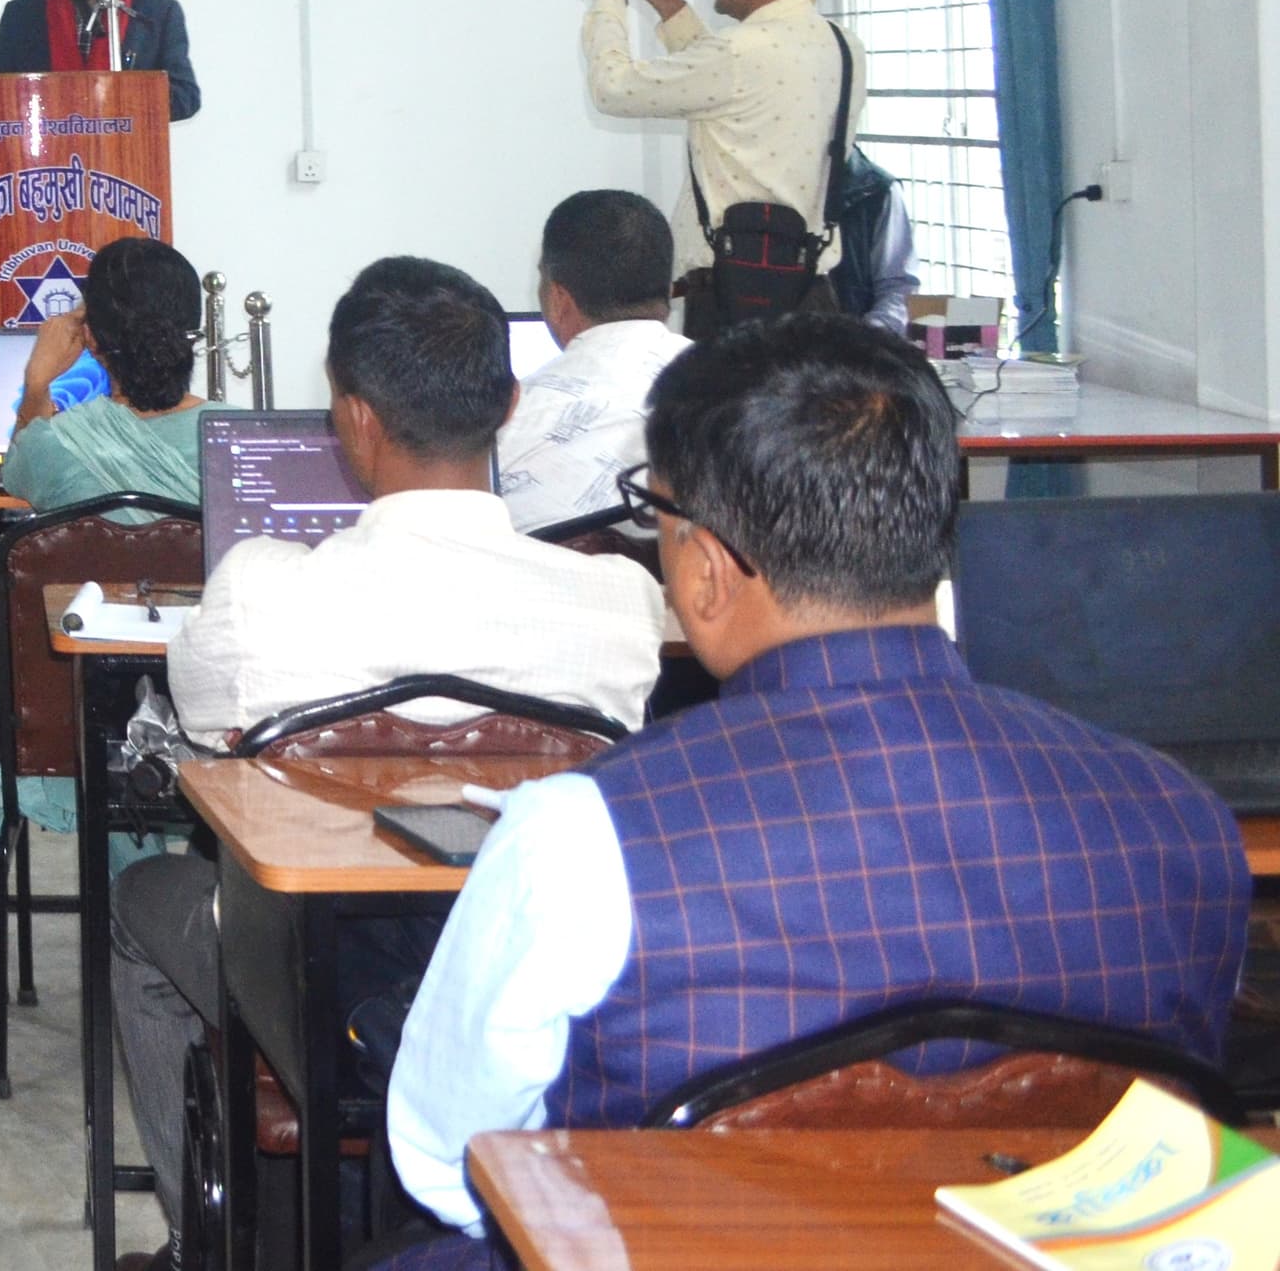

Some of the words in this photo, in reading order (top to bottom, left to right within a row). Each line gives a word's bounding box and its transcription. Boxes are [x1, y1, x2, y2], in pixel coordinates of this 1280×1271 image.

[18, 153, 85, 222] बहुमुखी
[89, 169, 161, 240] क्याम्पस
[57, 238, 97, 262] Unive
